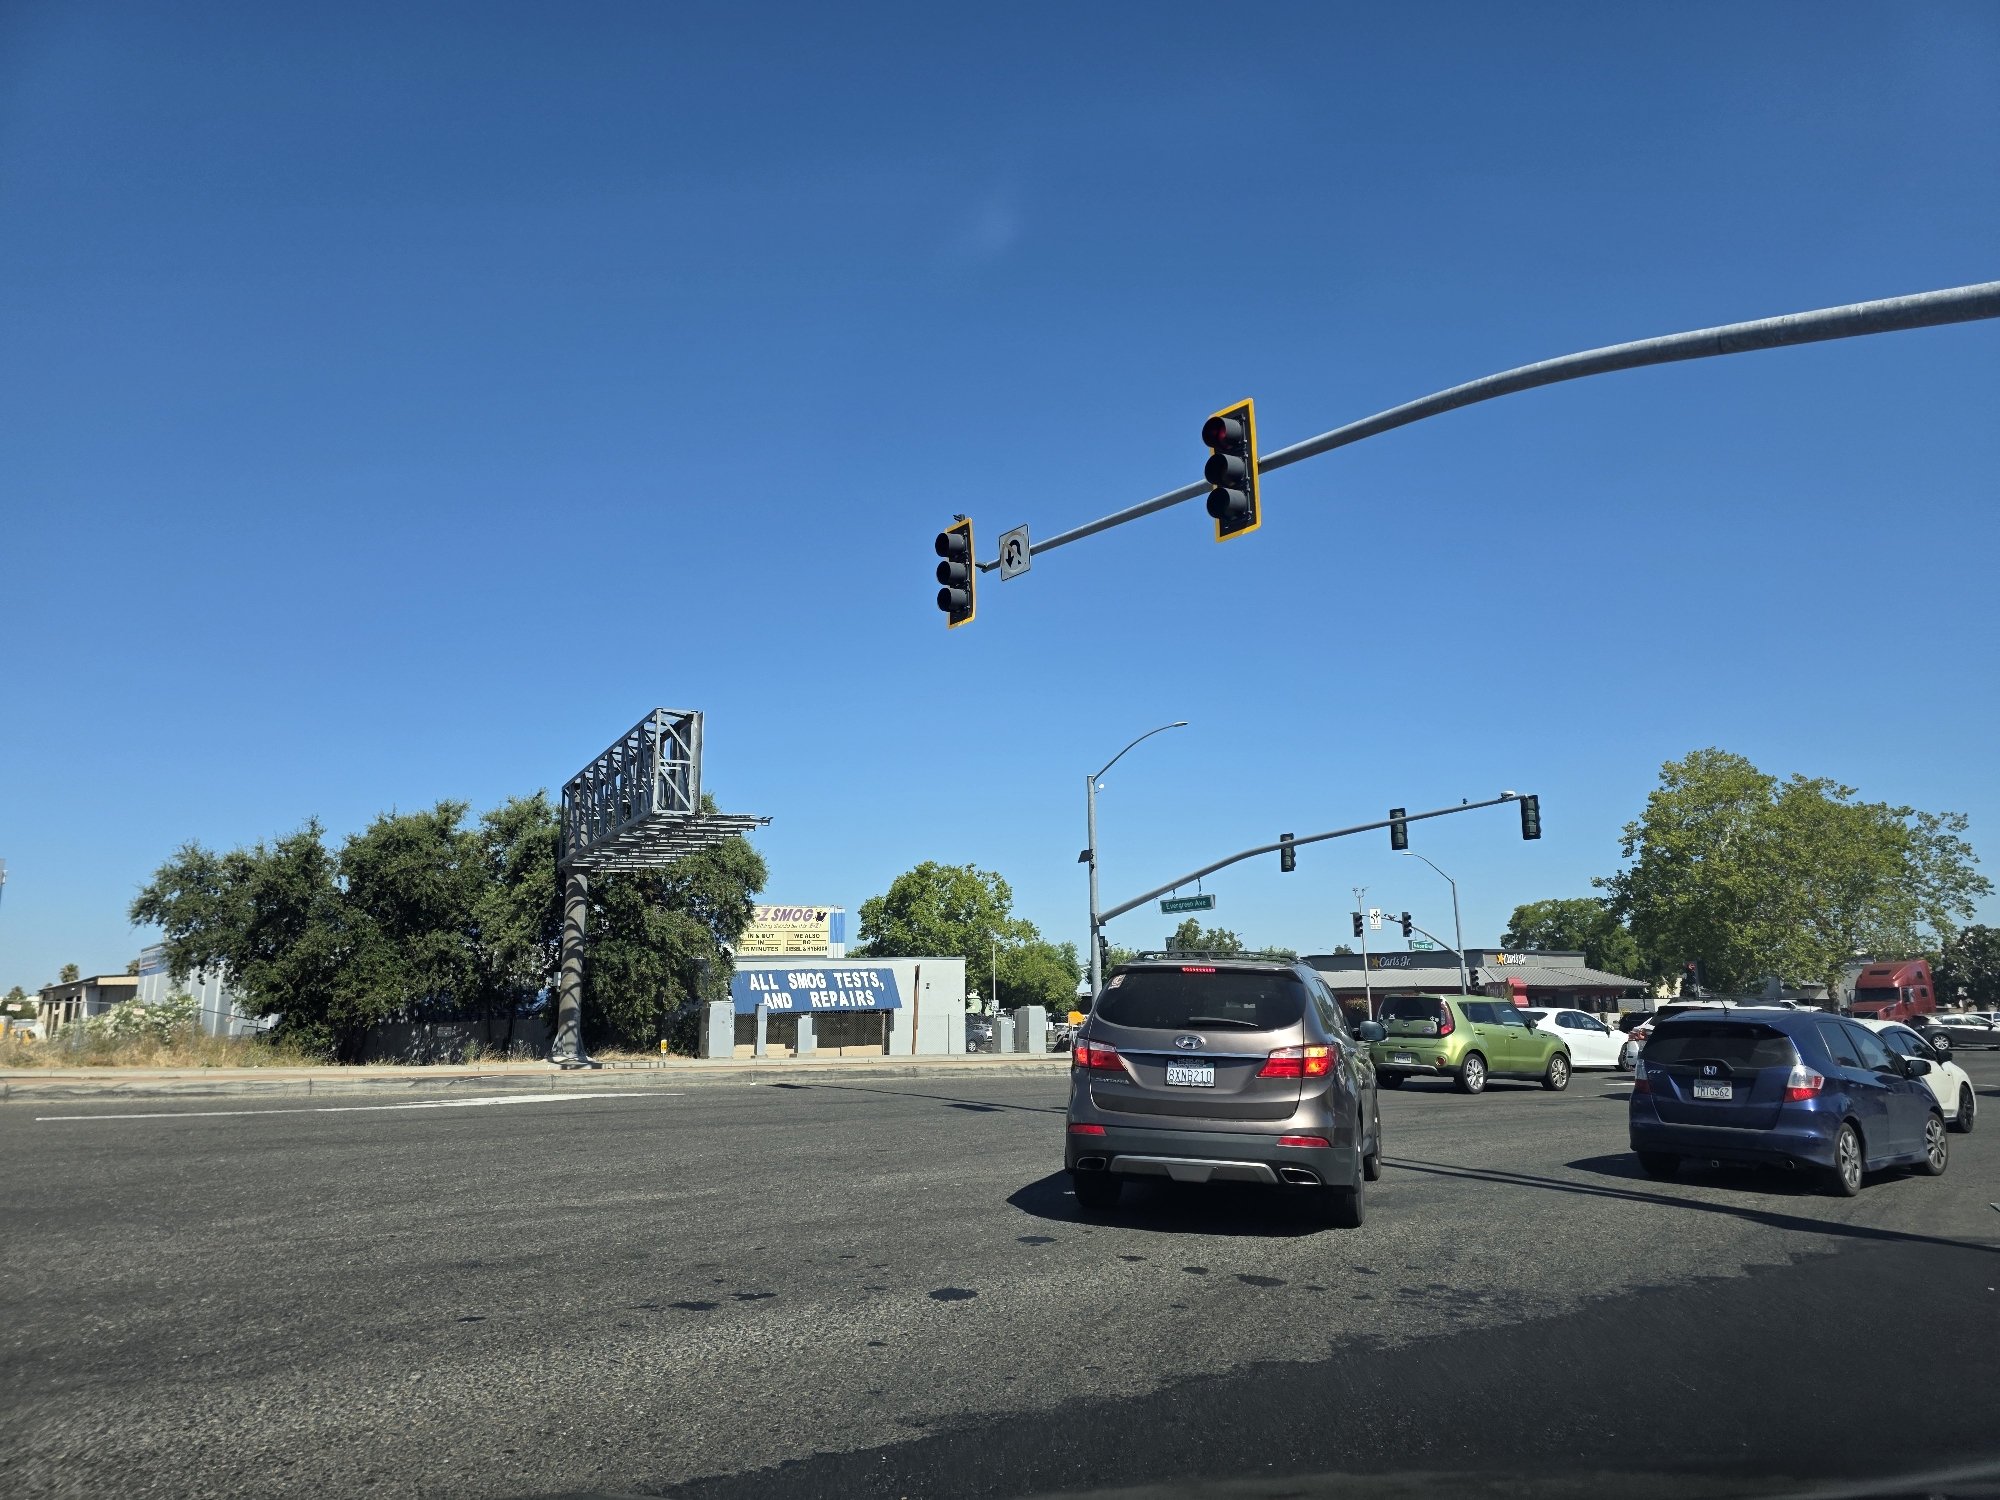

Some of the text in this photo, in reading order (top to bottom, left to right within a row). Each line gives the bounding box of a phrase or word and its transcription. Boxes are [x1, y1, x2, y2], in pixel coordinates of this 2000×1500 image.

[1165, 899, 1207, 909] Evergreen Ave
[771, 908, 814, 922] SMOG
[1380, 956, 1400, 967] Carl's
[750, 971, 885, 991] ALL SMOG TESTS,
[763, 990, 876, 1009] AND REPAIRS
